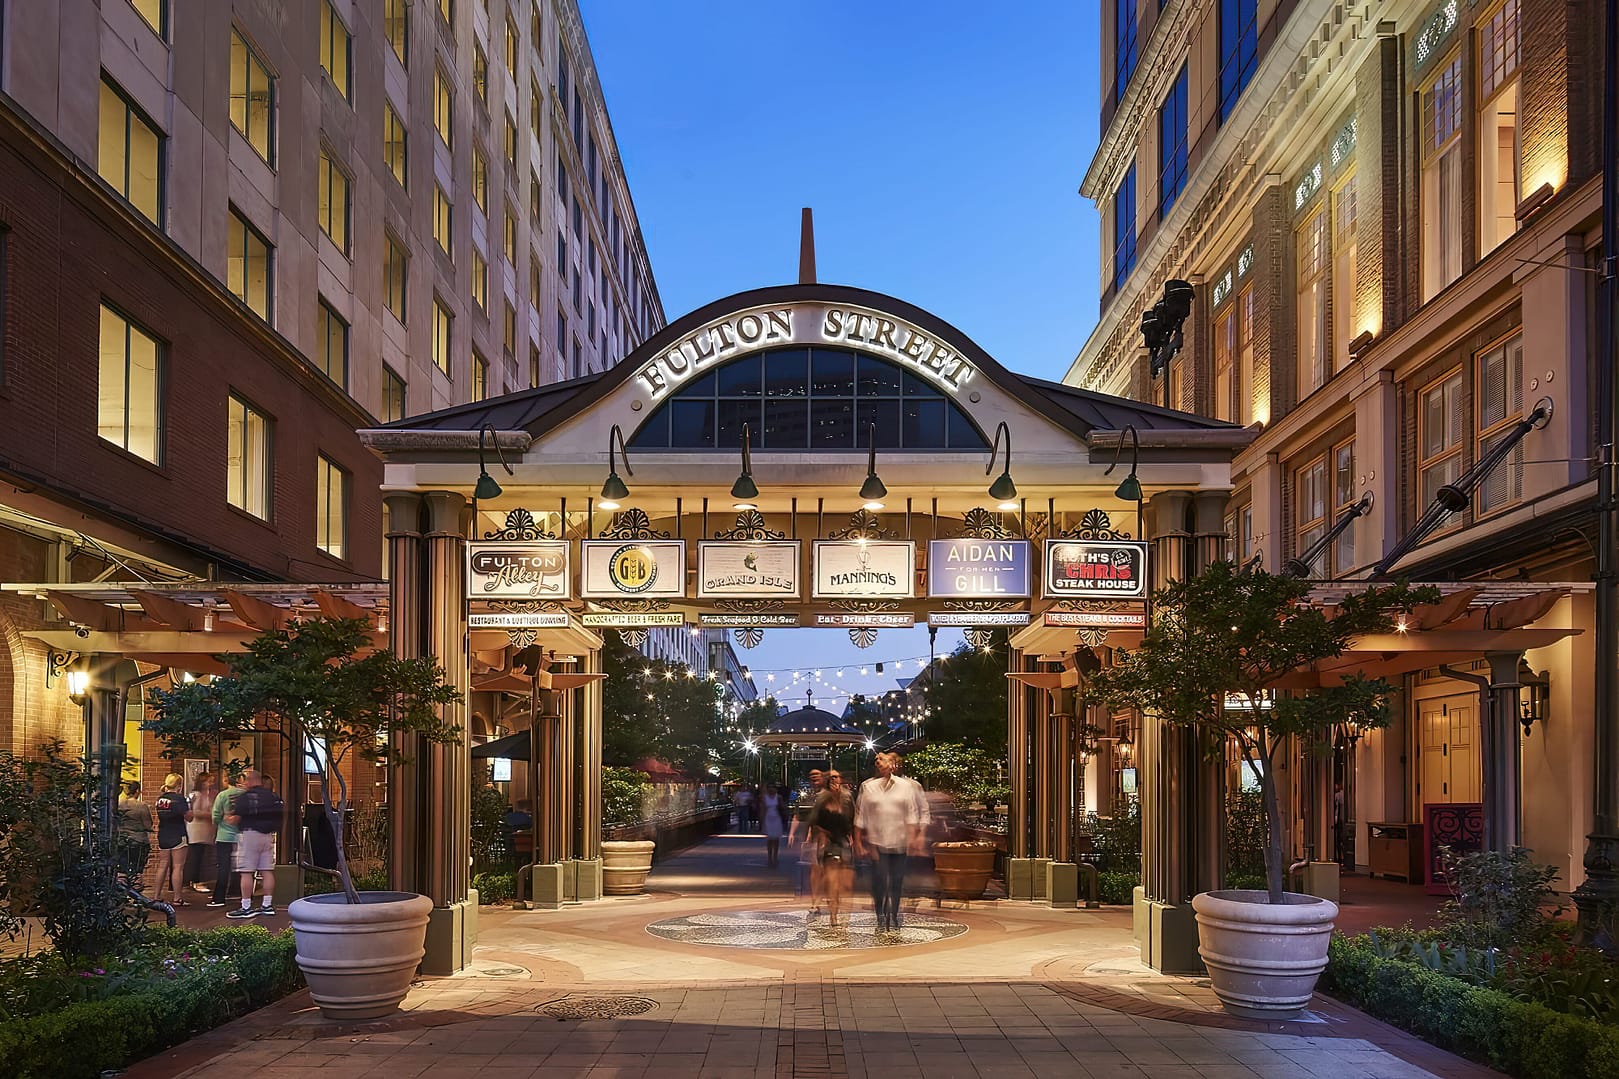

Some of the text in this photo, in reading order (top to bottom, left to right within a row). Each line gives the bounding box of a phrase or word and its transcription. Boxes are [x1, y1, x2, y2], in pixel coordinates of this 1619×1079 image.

[637, 309, 975, 397] FULTON STREET
[480, 557, 556, 567] FULTON
[947, 545, 1014, 562] AIDAN
[830, 571, 897, 586] MANNING'S
[1065, 562, 1132, 579] CHRIS
[484, 565, 559, 597] Alley
[706, 575, 793, 589] GRAND ISLE
[955, 575, 1006, 593] GILL
[1056, 579, 1137, 589] STEAK HOUSE
